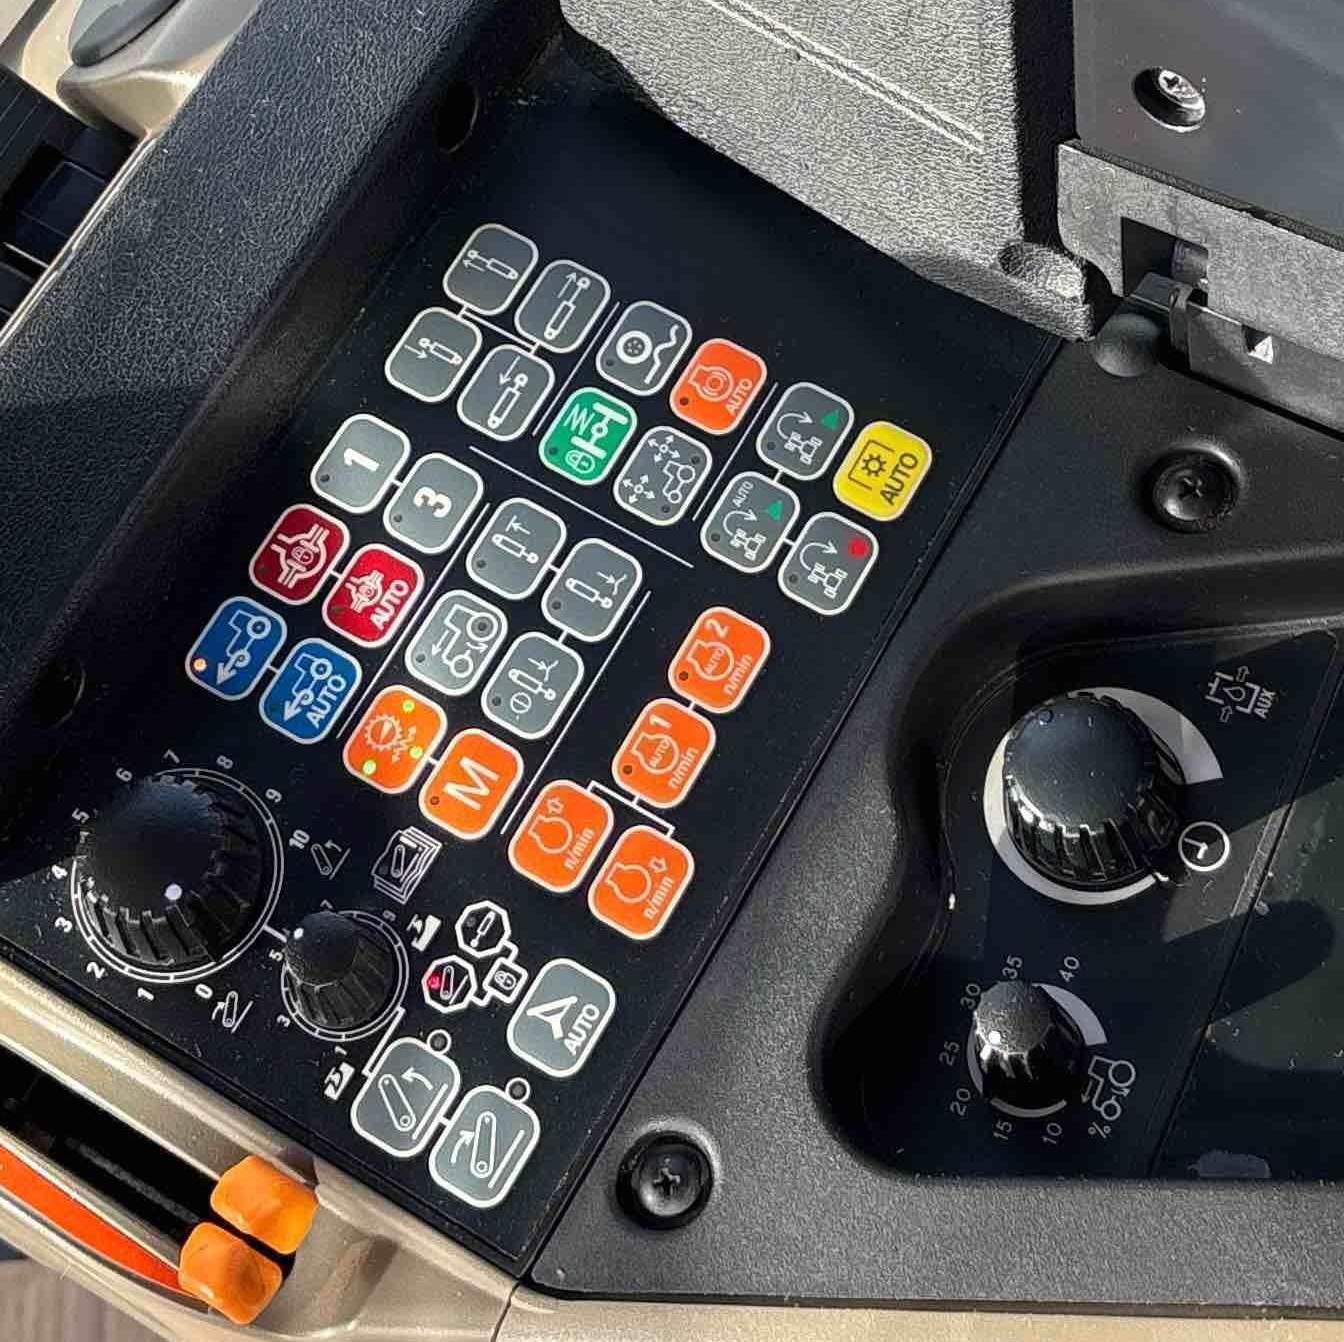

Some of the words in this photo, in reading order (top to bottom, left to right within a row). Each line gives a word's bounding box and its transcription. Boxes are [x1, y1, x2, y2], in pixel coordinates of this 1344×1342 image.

[726, 379, 753, 415] AUTO
[344, 448, 380, 471] 1
[880, 452, 919, 506] AUTO
[414, 487, 452, 518] 3
[732, 480, 754, 507] AUTO
[369, 579, 408, 631] AUTO
[705, 619, 729, 638] 2
[704, 648, 726, 675] AUTO
[723, 654, 753, 696] n/min
[306, 673, 347, 728] AUTO
[1254, 689, 1277, 719] AUX
[650, 714, 672, 729] 1
[163, 749, 181, 764] 7
[216, 755, 234, 769] 8
[648, 739, 671, 768] AUTO
[116, 767, 133, 783] 6
[668, 747, 699, 789] n/min
[265, 788, 282, 803] 9
[444, 756, 501, 811] M
[72, 808, 90, 823] 5
[288, 829, 311, 850] 10
[563, 827, 595, 871] n/min
[51, 864, 68, 880] 4
[643, 876, 673, 920] n/min
[54, 916, 73, 933] 3
[269, 949, 283, 962] 5
[1001, 955, 1024, 979] 35
[86, 961, 105, 979] 2
[1058, 955, 1081, 983] 40
[136, 987, 154, 1001] 1
[195, 983, 214, 999] 0
[960, 982, 982, 1011] 30
[277, 1014, 291, 1028] 3
[564, 1002, 600, 1056] AUTO
[334, 1045, 347, 1055] 1
[939, 1040, 960, 1067] 25
[950, 1088, 972, 1117] 20
[992, 1120, 1014, 1141] 15
[1042, 1123, 1063, 1145] 10
